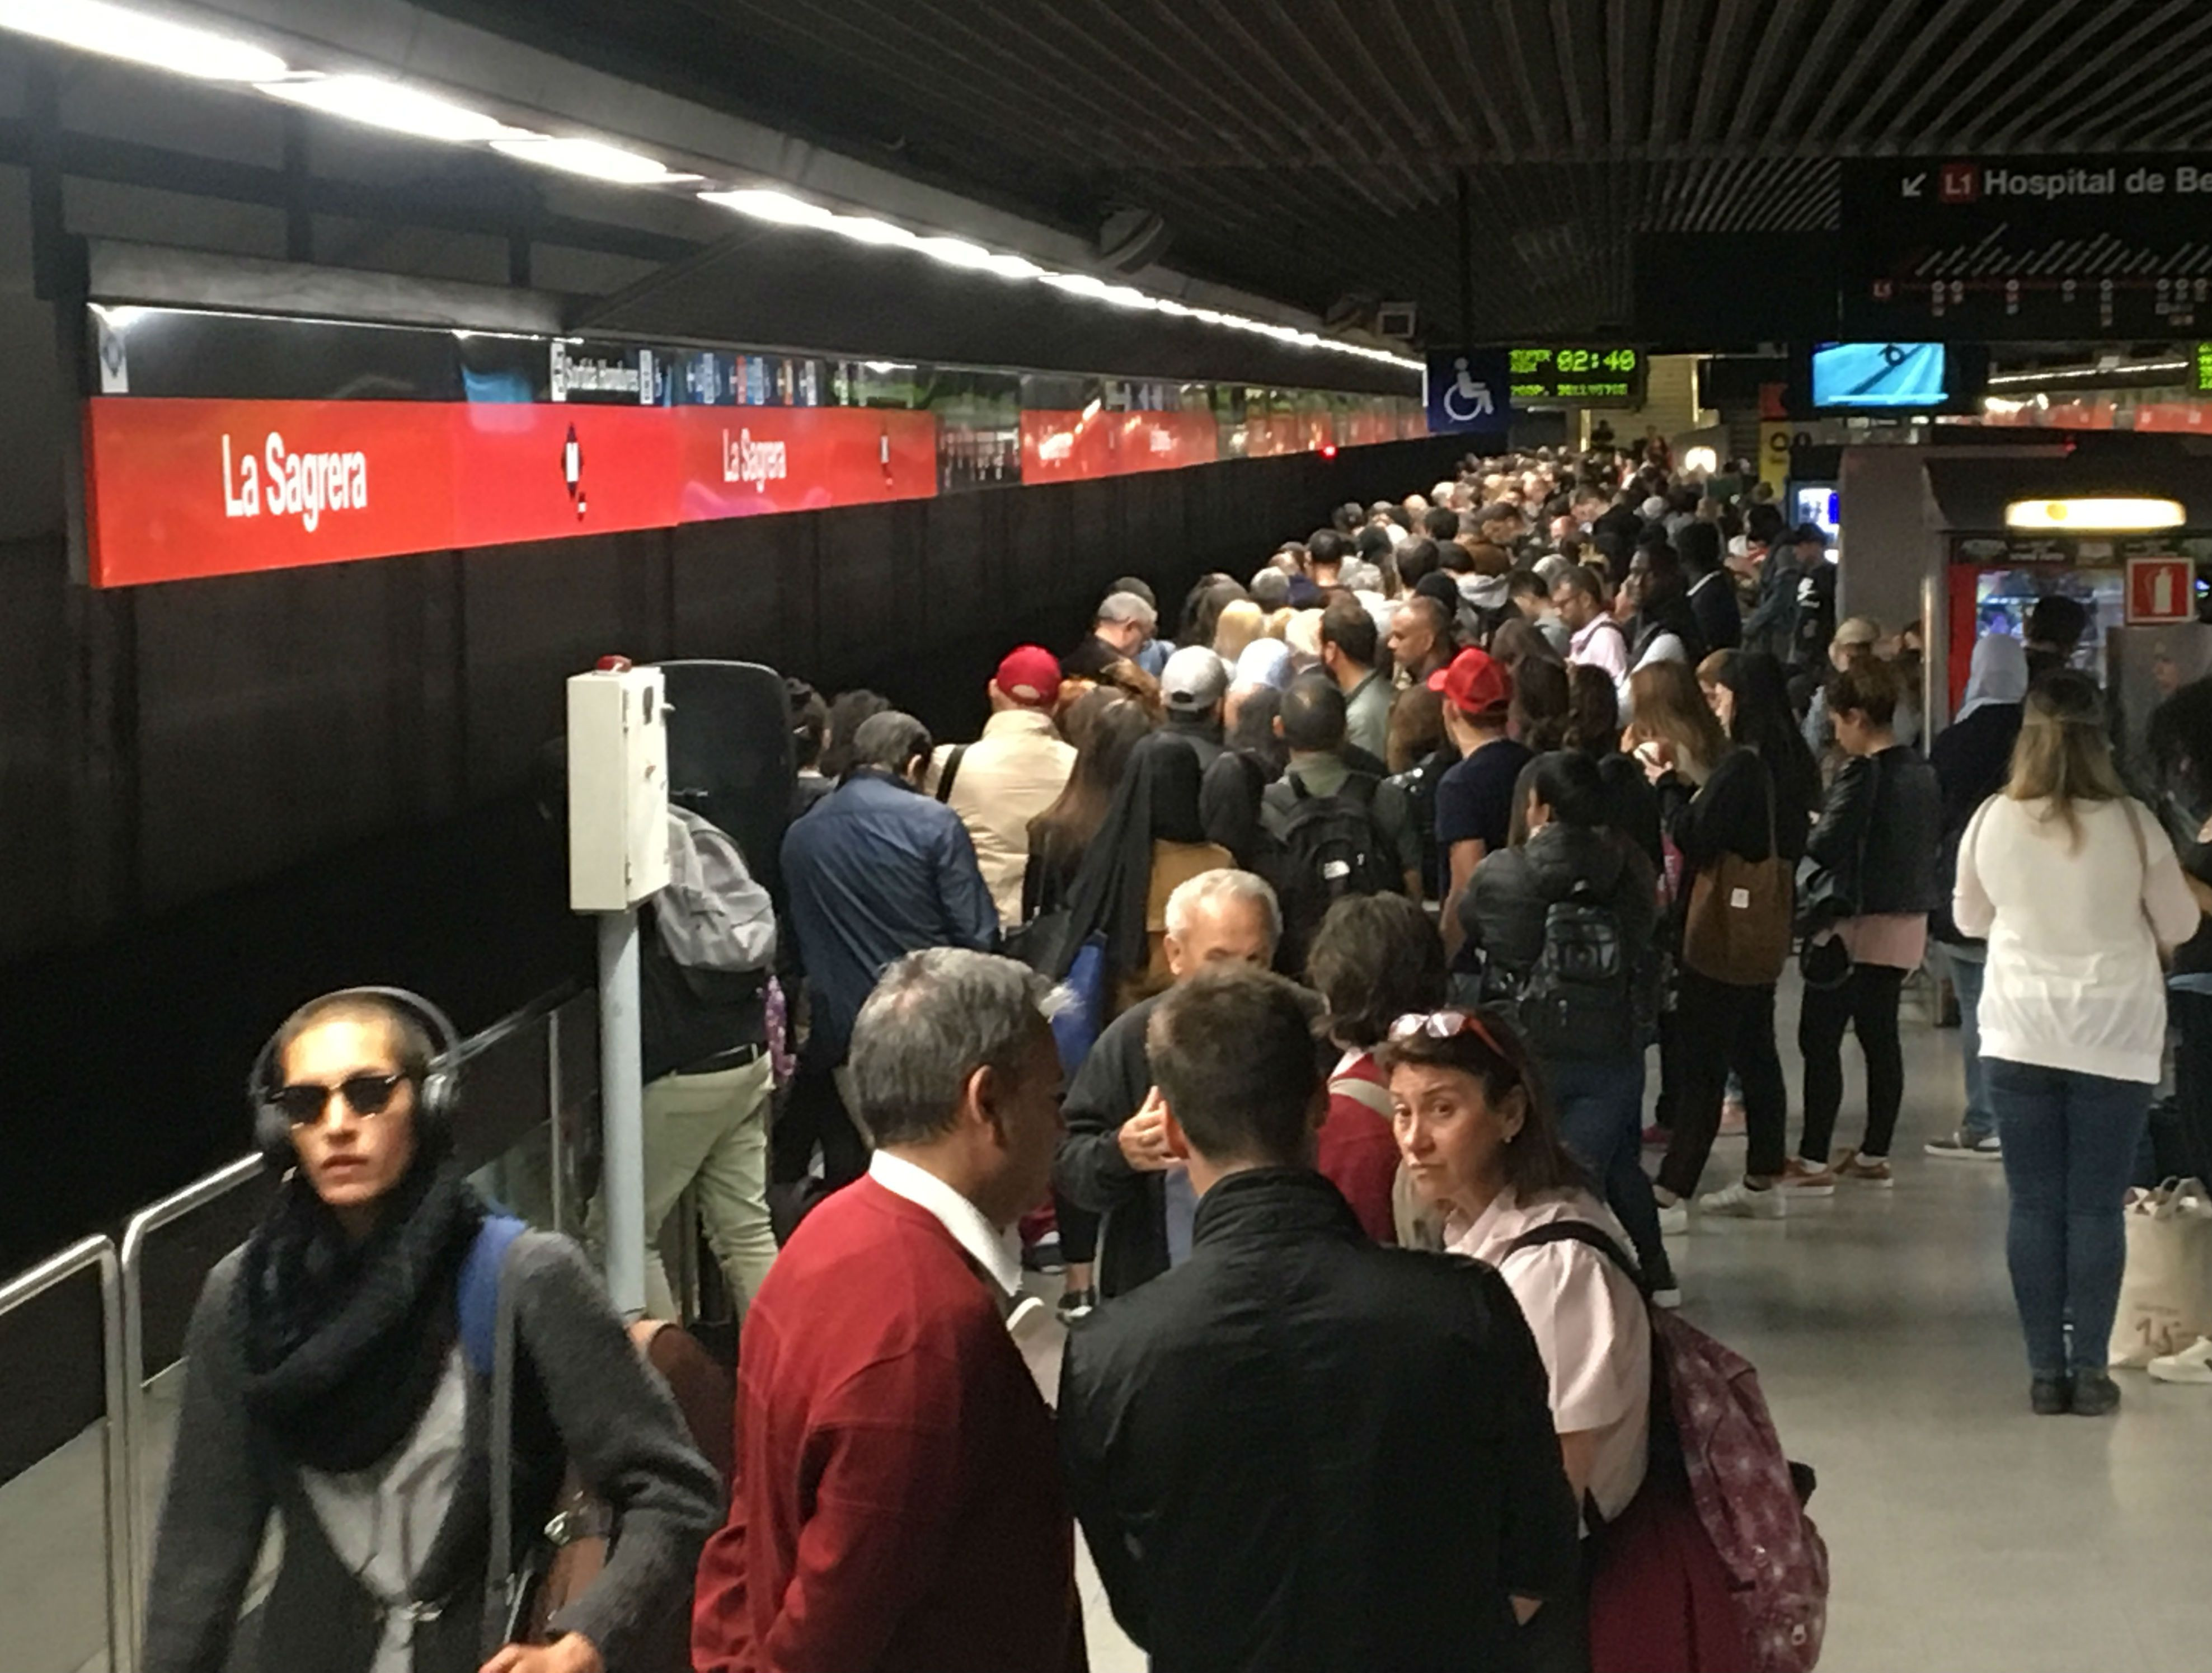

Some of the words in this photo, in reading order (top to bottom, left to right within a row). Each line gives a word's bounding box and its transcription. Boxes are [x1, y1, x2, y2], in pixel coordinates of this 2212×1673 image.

[1945, 172, 1971, 195] L1
[1984, 168, 2116, 200] Hospital
[2124, 167, 2165, 193] de
[1557, 349, 1636, 372] 02:40
[222, 433, 260, 518] La
[265, 431, 367, 532] Sagrera
[722, 428, 739, 482] La
[740, 427, 787, 493] Sagrera
